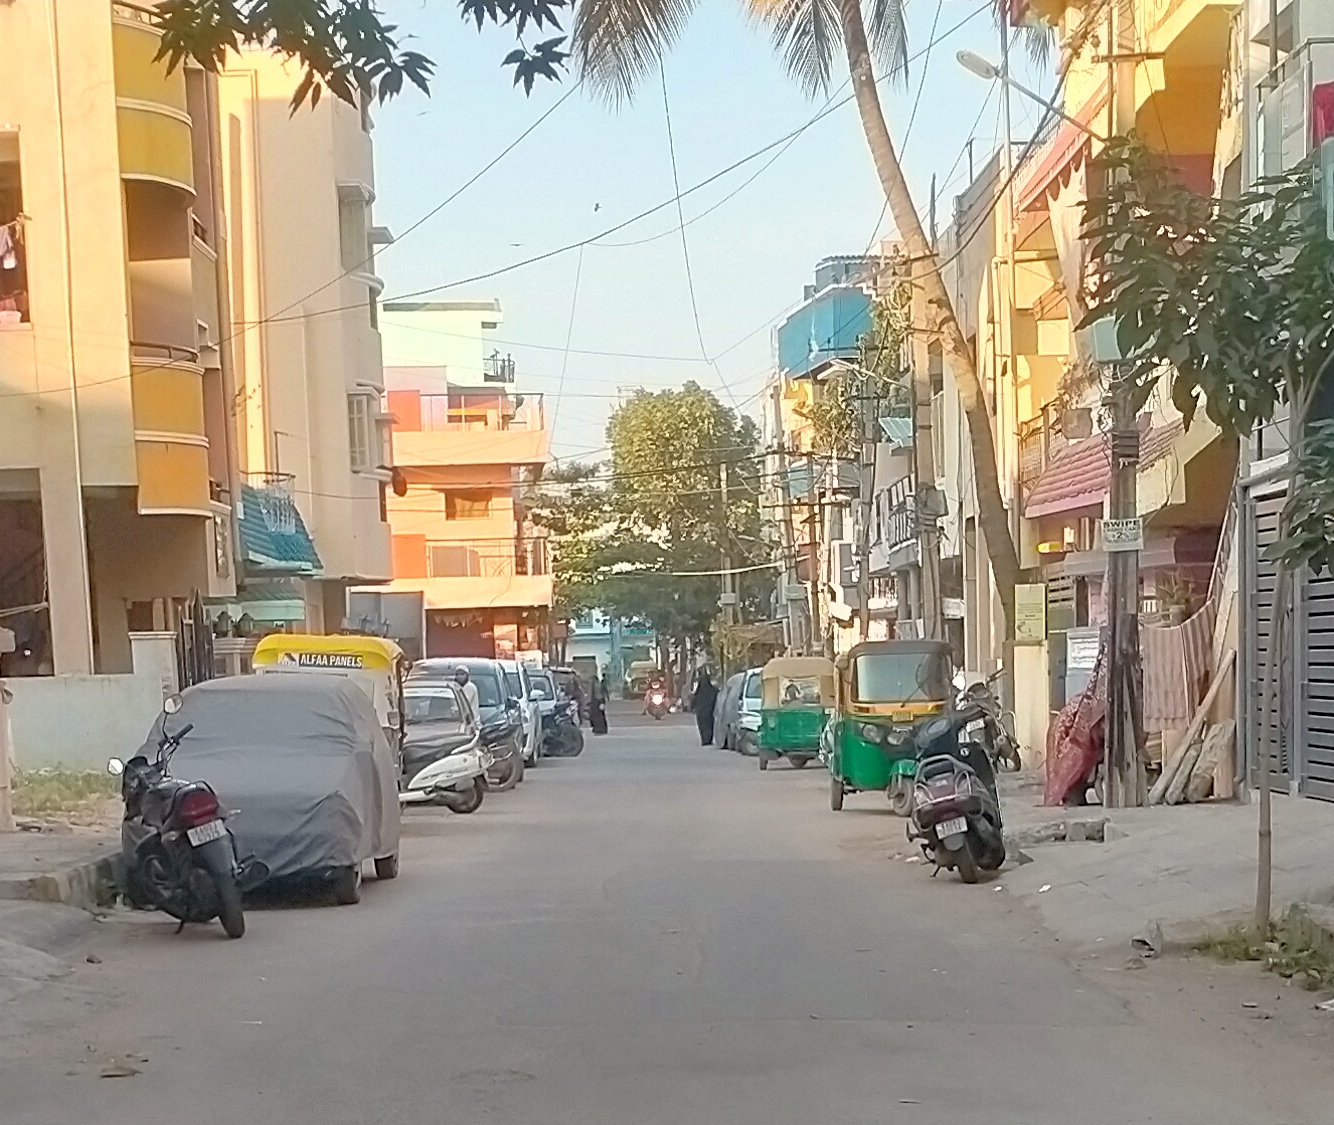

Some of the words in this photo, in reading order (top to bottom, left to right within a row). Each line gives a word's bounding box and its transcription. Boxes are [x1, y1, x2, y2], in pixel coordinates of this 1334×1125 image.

[1103, 520, 1140, 528] SWIPE
[300, 653, 328, 666] ALFAA
[329, 655, 363, 668] PANELS
